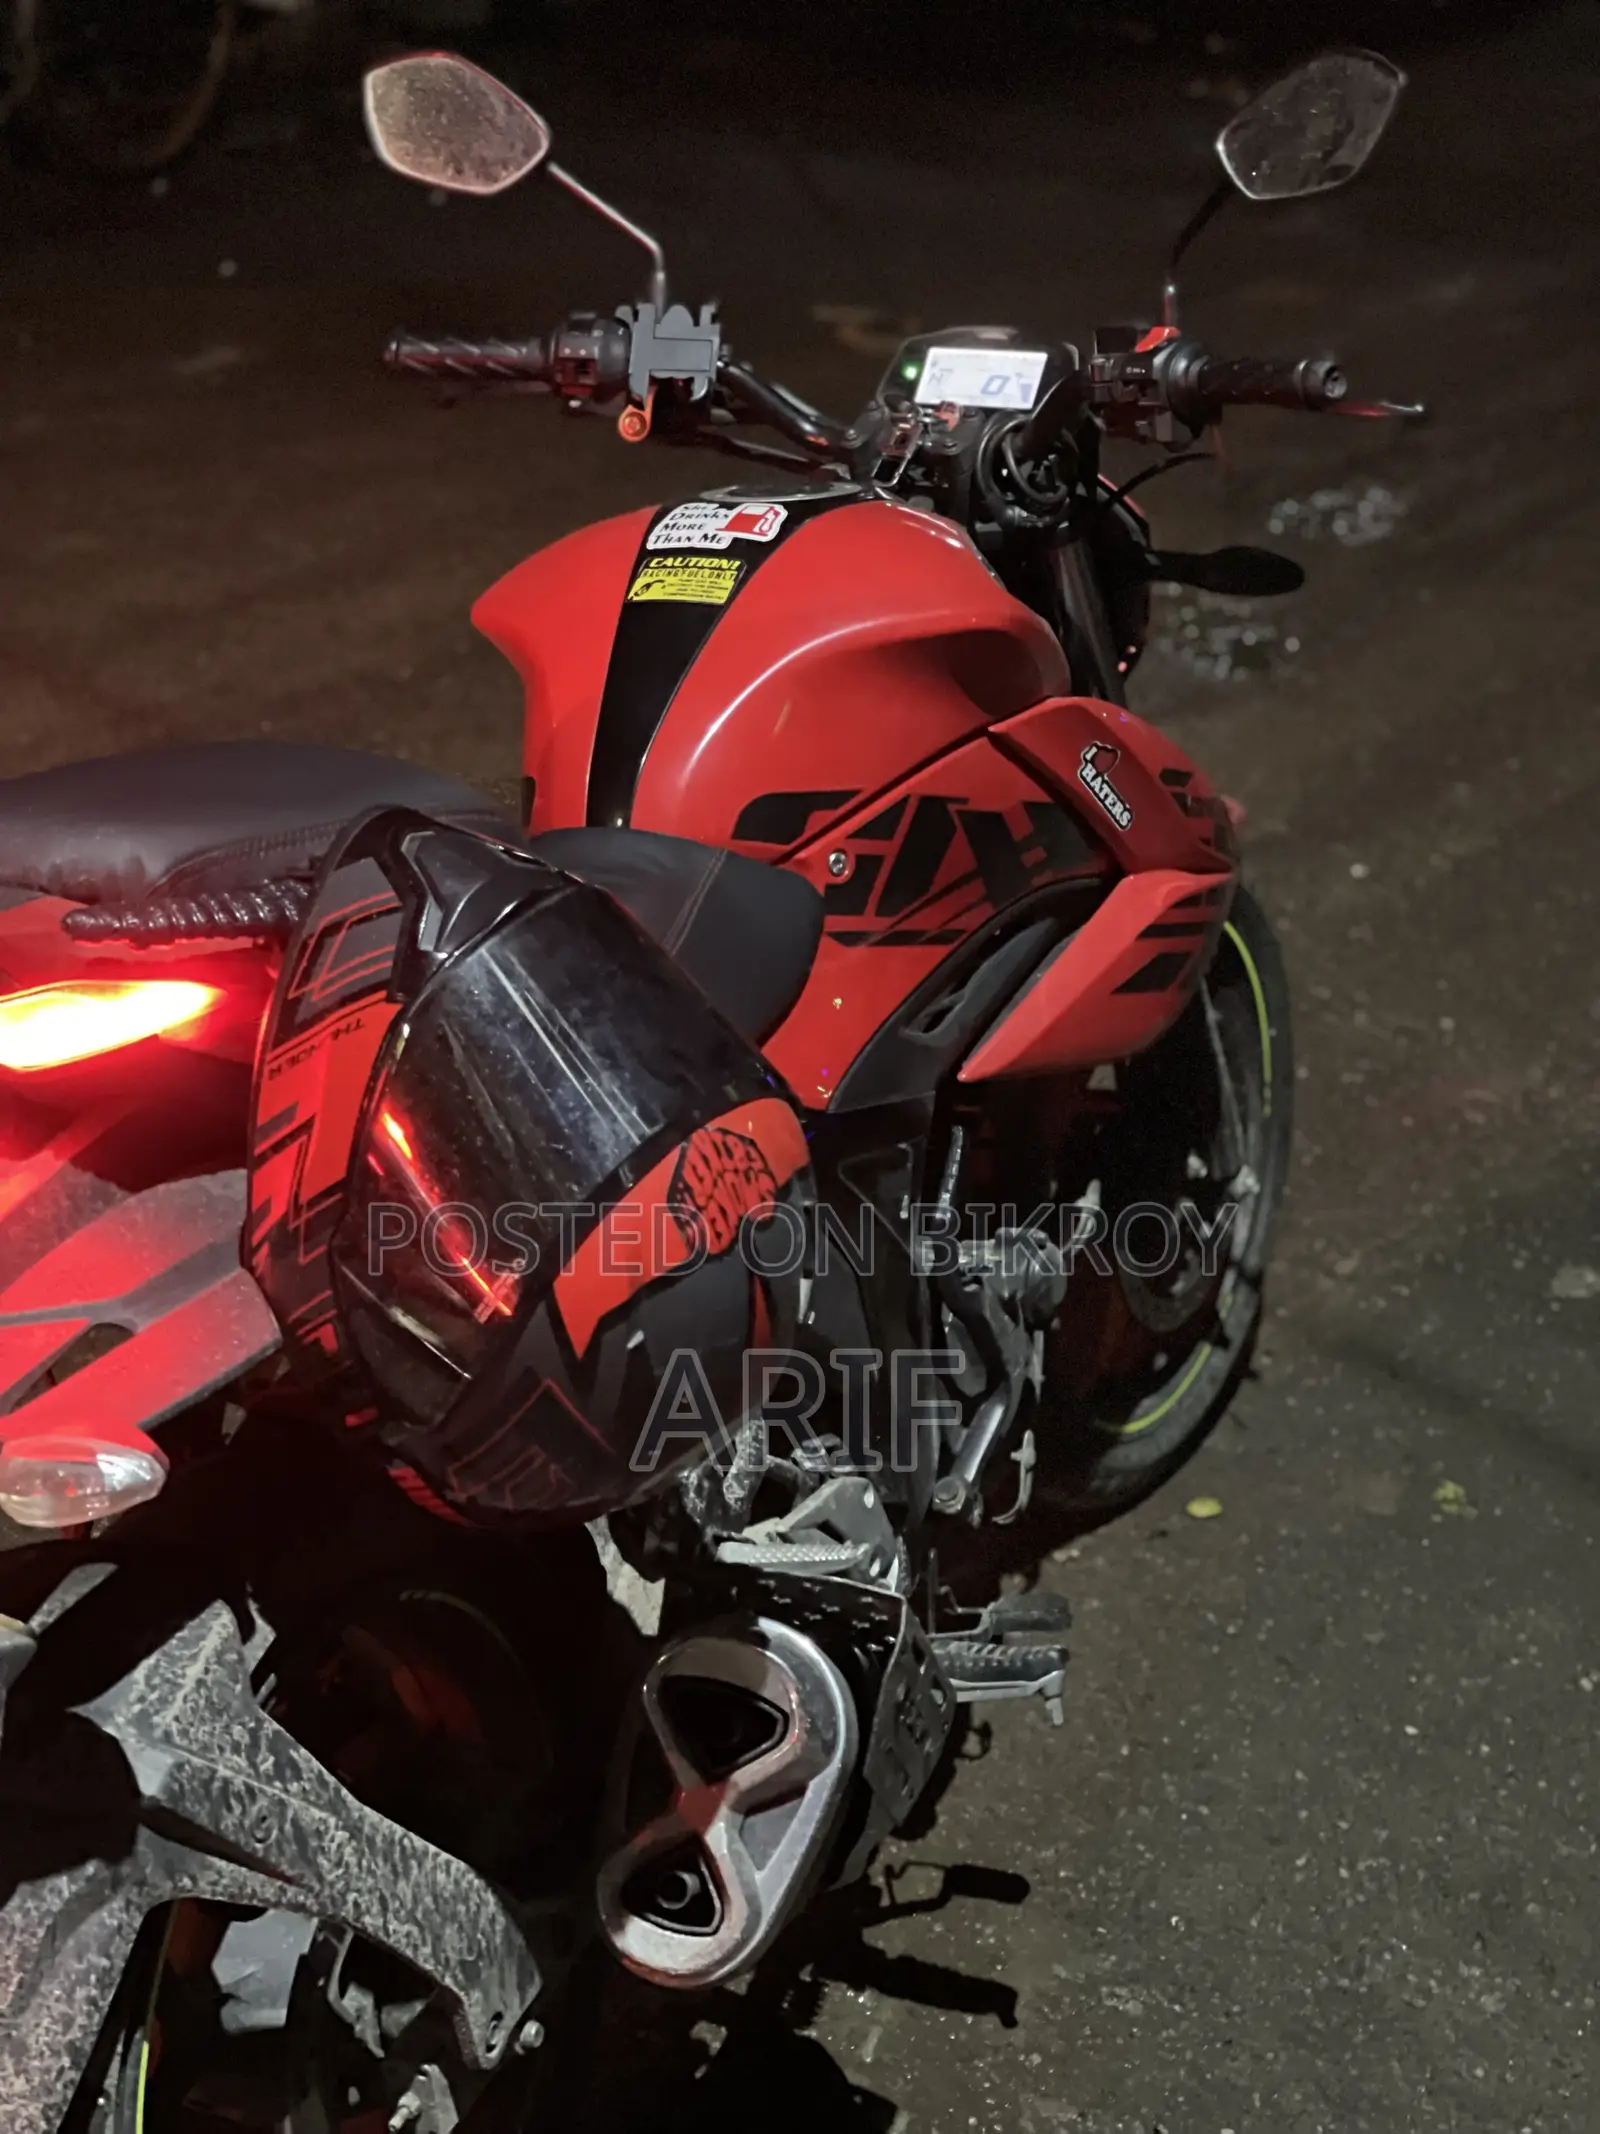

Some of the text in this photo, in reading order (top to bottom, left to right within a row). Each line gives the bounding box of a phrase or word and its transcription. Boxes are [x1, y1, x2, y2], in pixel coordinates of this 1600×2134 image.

[980, 374, 1011, 396] 0
[642, 568, 681, 578] RACING
[681, 569, 705, 579] FUEL
[649, 556, 741, 570] CAUTION!
[1081, 762, 1132, 827] HATERS
[268, 1017, 365, 1081] THNDER
